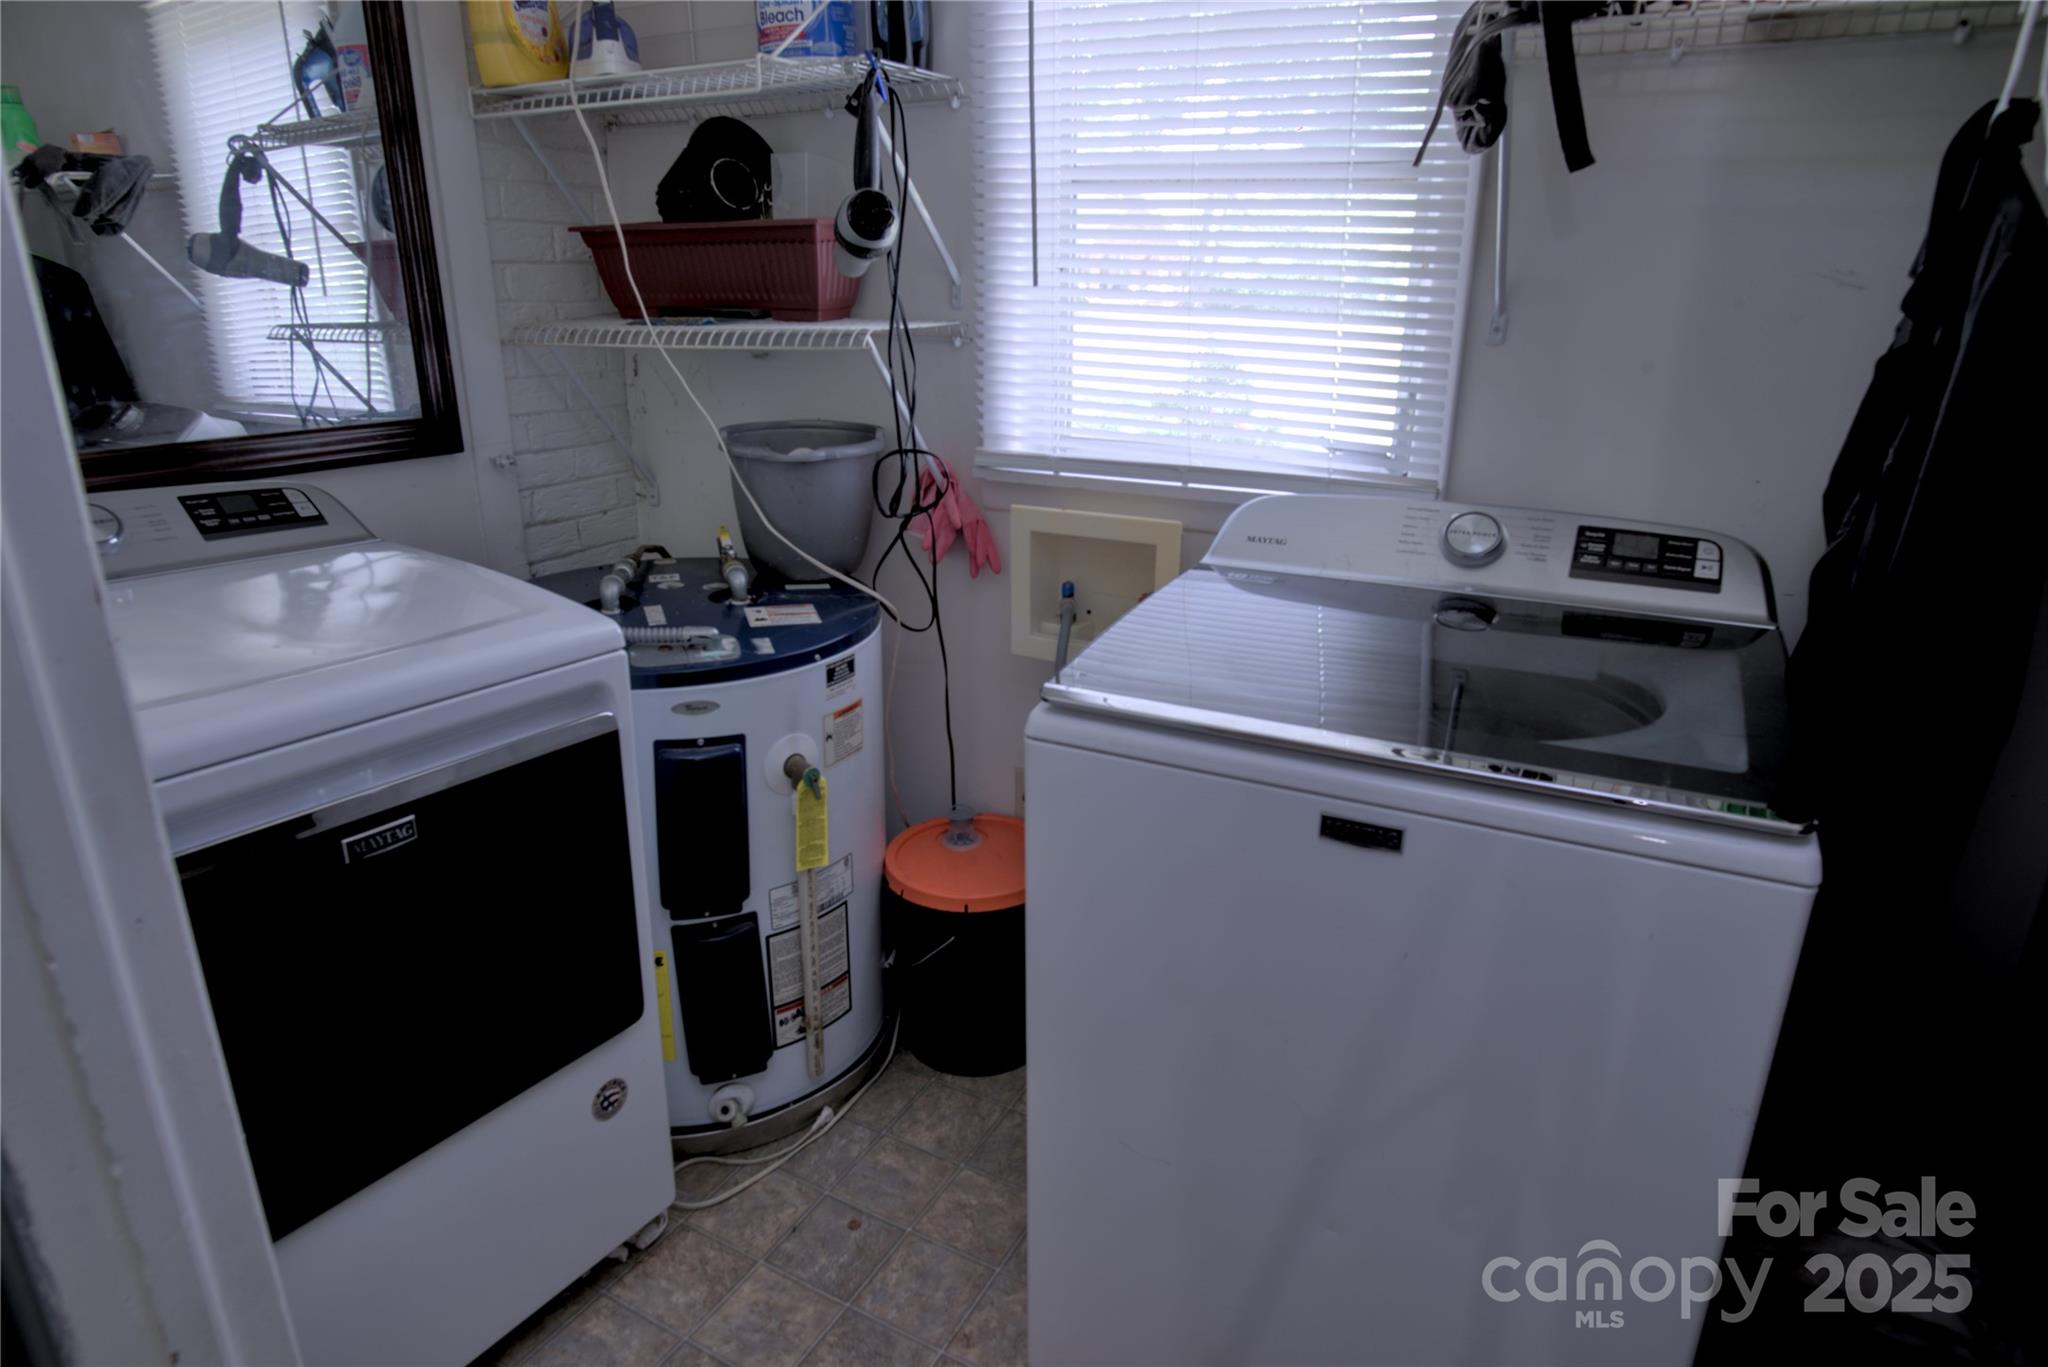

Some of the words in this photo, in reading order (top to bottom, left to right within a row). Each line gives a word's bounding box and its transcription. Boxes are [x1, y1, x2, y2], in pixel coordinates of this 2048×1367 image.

[760, 7, 805, 26] Bleach
[1245, 535, 1288, 547] MAYTAG
[353, 824, 413, 853] MAYTAG
